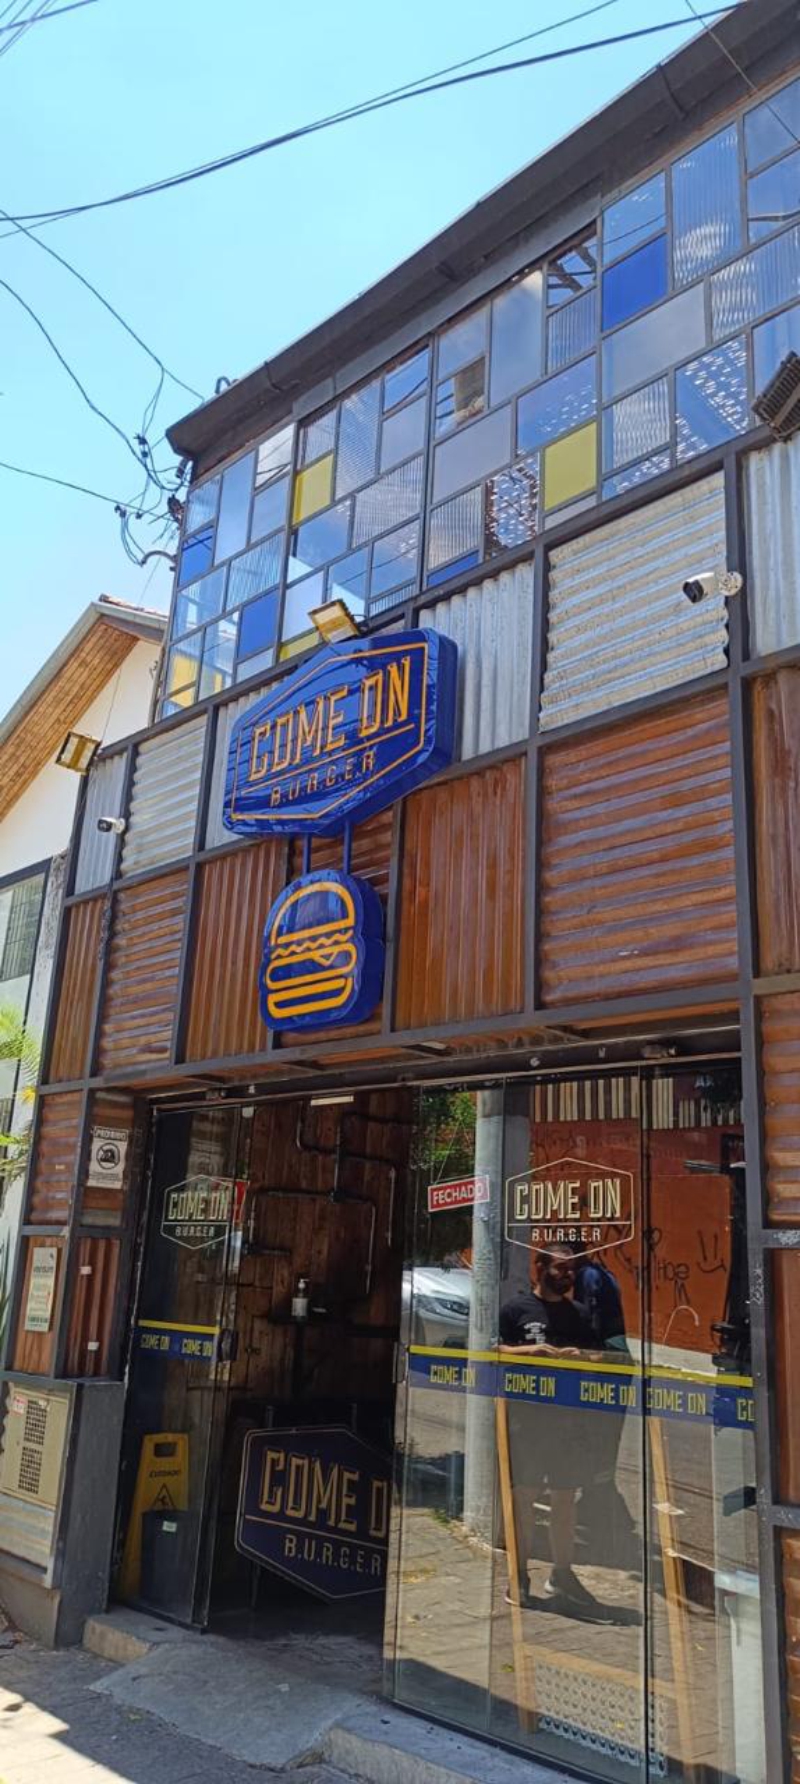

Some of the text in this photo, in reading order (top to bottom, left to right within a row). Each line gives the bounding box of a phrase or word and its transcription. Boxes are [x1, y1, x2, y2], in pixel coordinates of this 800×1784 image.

[248, 656, 411, 781] COME ON
[168, 1189, 230, 1220] COME ON
[432, 1182, 485, 1205] FECHADO
[514, 1178, 621, 1219] COME ON
[429, 1364, 476, 1387] COME ON
[505, 1372, 556, 1397] COME ON
[580, 1381, 637, 1407] COME ON
[646, 1387, 706, 1415] COME ON
[259, 1447, 388, 1538] COME O
